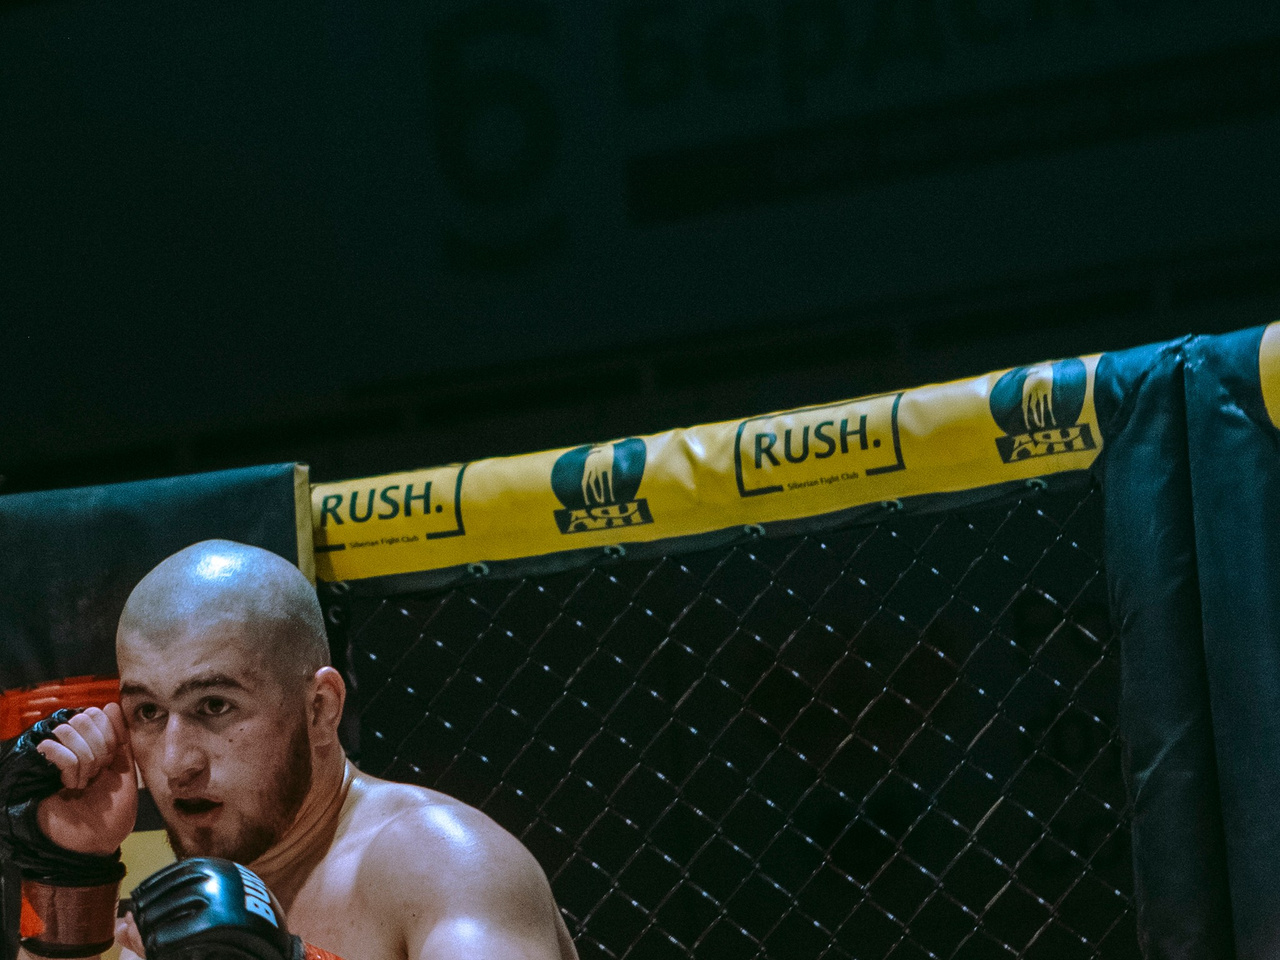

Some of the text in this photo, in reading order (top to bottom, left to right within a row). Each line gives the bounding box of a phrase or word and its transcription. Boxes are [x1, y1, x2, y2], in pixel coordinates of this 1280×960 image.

[754, 413, 882, 469] RUSH.
[840, 471, 859, 481] Club
[320, 481, 443, 528] RUSH.
